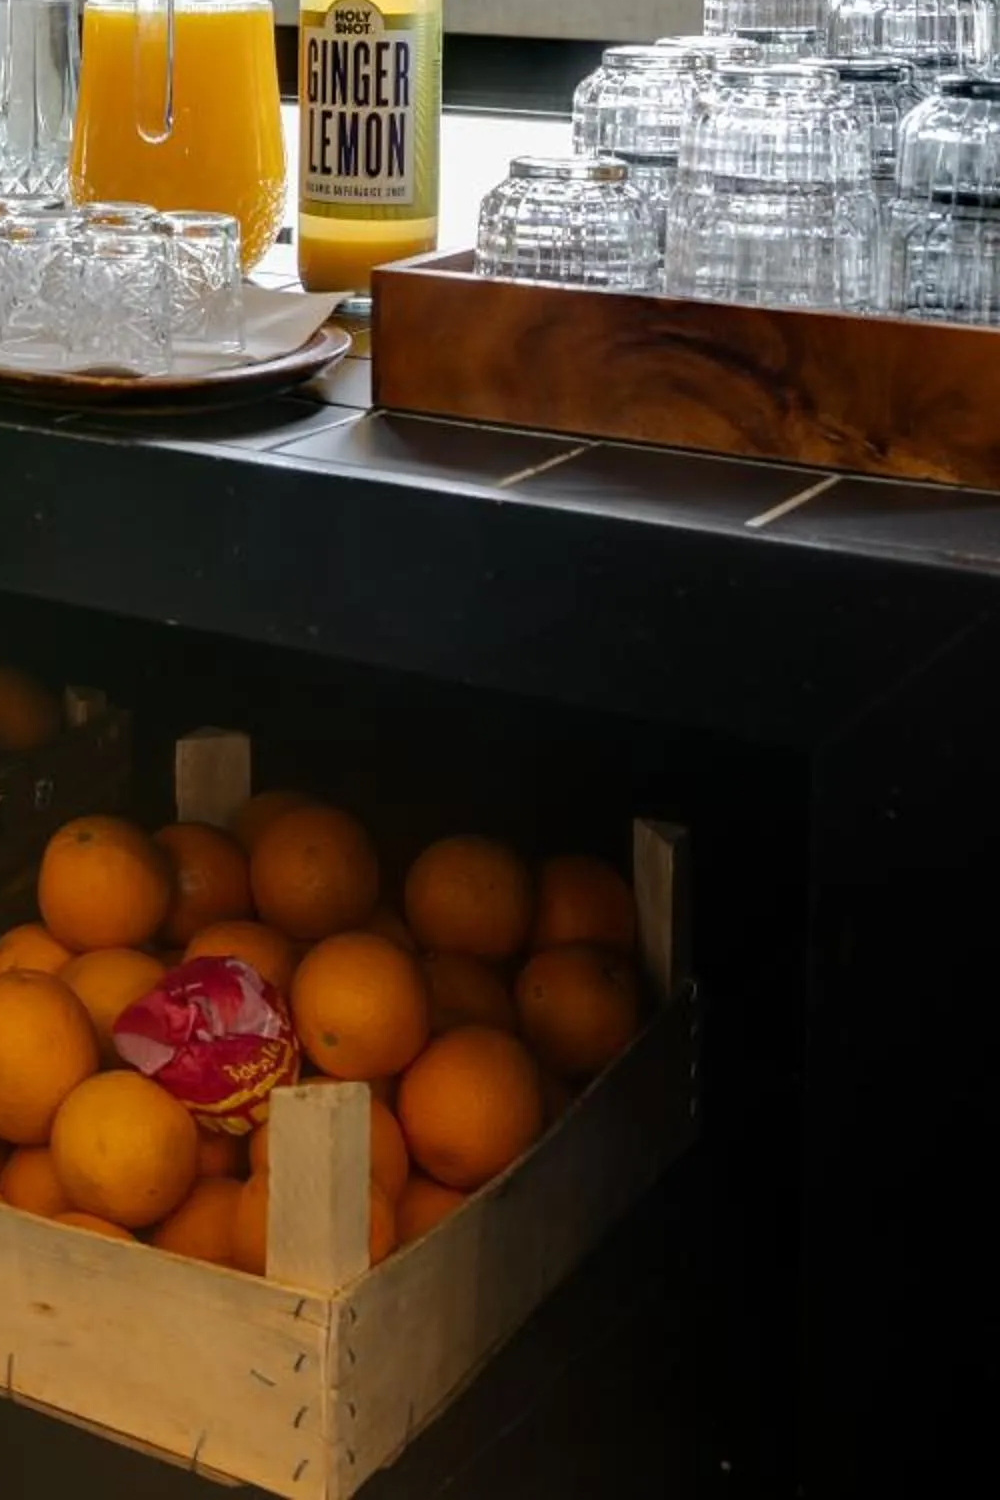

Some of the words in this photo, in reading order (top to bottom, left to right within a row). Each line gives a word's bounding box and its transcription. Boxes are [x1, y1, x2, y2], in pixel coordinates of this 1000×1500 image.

[335, 10, 371, 23] HOLY
[335, 23, 371, 34] SHOT
[308, 38, 409, 107] GINGER
[309, 108, 405, 178] LEMON
